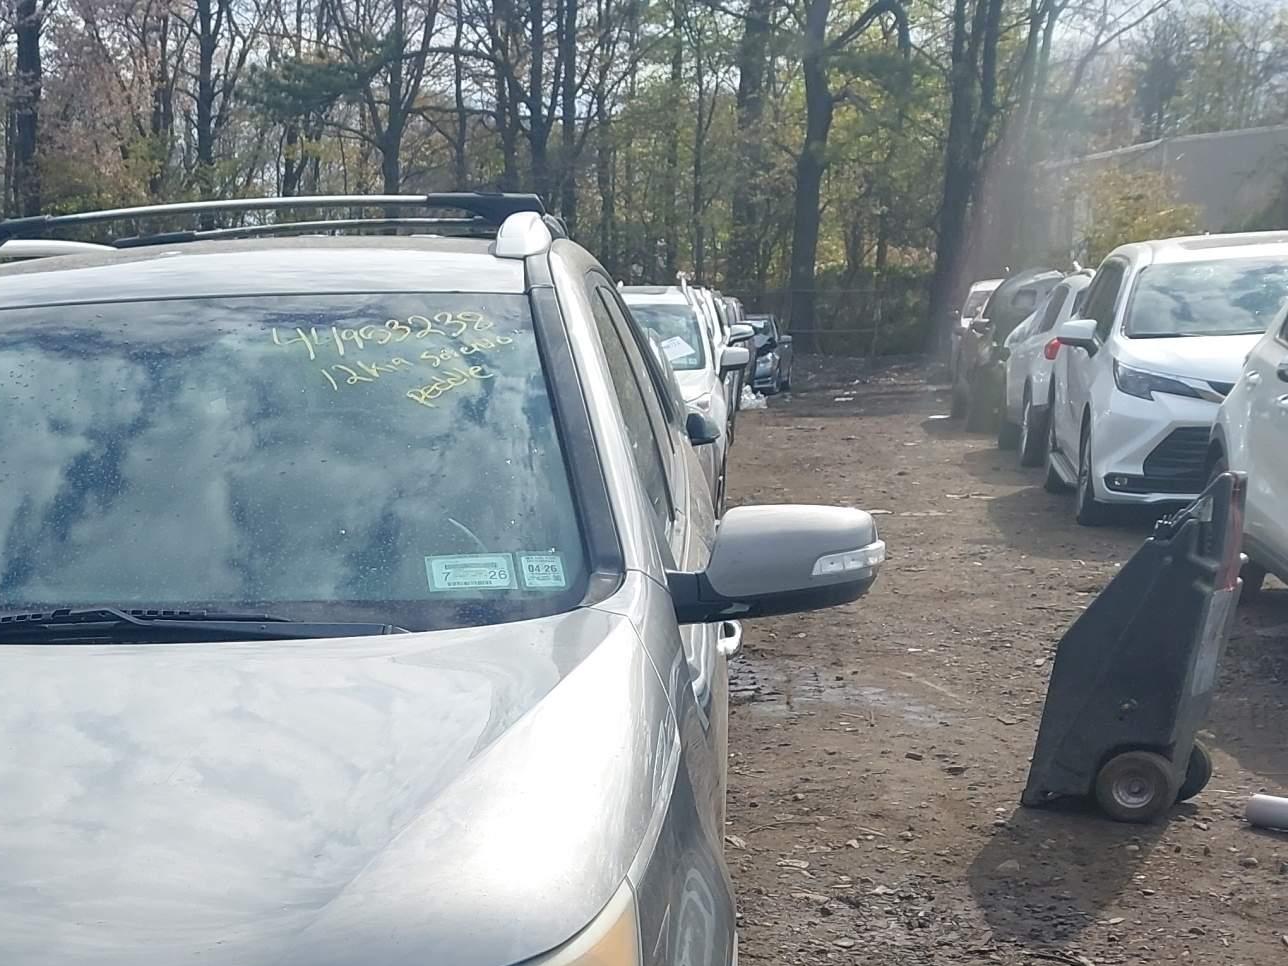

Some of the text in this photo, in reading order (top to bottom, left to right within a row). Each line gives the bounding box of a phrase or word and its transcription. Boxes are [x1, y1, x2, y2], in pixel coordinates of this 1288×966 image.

[527, 564, 558, 573] 04 26
[488, 570, 508, 580] 26
